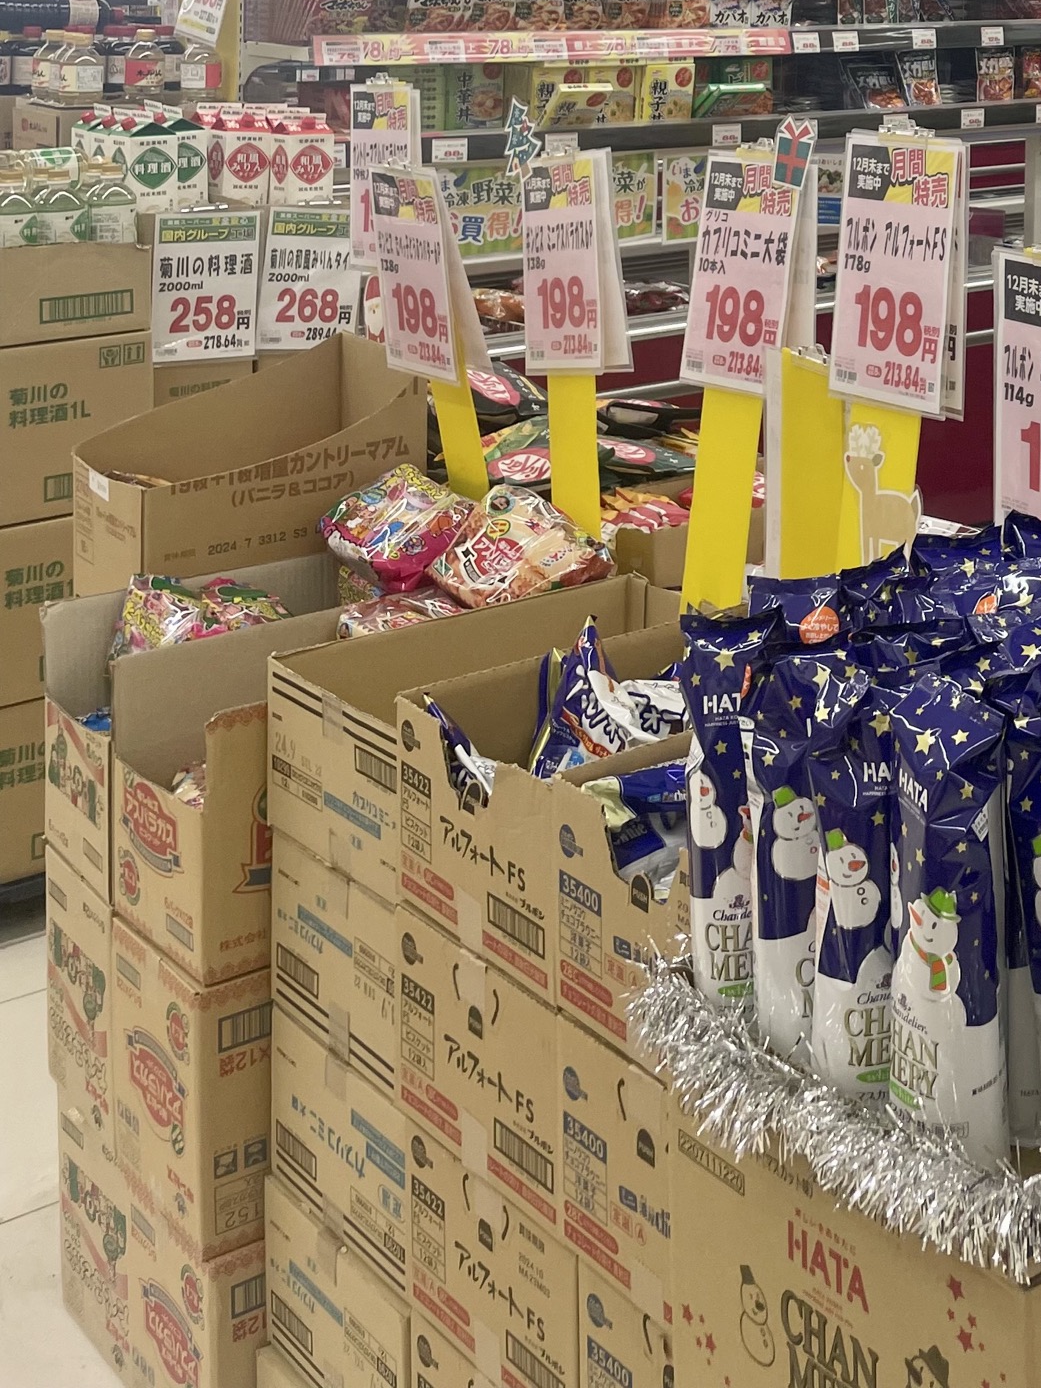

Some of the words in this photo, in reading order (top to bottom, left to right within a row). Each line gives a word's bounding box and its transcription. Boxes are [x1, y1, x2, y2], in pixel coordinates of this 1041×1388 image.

[457, 71, 475, 124] 中華丼
[134, 162, 171, 176] 料理酒
[743, 164, 773, 195] 月間
[853, 156, 891, 176] 12月末まで
[891, 148, 926, 183] 月間
[711, 171, 744, 190] 12月末まで
[713, 187, 736, 202] 実施中
[857, 174, 882, 191] 実施中
[913, 173, 949, 209] 特売
[706, 209, 729, 224] グリコ
[761, 189, 793, 217] 特売
[161, 227, 255, 242] 国内グループ工場
[702, 224, 789, 267] カプリコミニ大袋
[846, 216, 877, 254] ブルボン
[884, 220, 947, 262] アルフォートFS
[159, 253, 253, 279] 菊川の料理酒
[527, 255, 545, 271] 138g
[698, 257, 726, 275] 10本入
[844, 252, 871, 273] 178g
[159, 281, 204, 293] 2000ml
[268, 273, 310, 283] 2000ml
[1004, 344, 1034, 383] ブルボン
[9, 383, 68, 407] 菊川の
[1004, 382, 1035, 408] 114g
[9, 400, 91, 429] 料理酒1L
[207, 539, 237, 556] 2024
[244, 537, 251, 550] 7
[258, 531, 286, 546] 3312
[293, 527, 307, 540] S3
[4, 560, 65, 588] 菊川の
[402, 763, 431, 795] 35422
[899, 768, 928, 813] HATA
[440, 815, 505, 877] アルフォート
[507, 860, 526, 892] FS
[562, 873, 600, 913] 35400
[402, 975, 434, 1008] 35422
[444, 1034, 513, 1104] アルフォート
[514, 1089, 535, 1124] FS
[565, 1115, 607, 1161] 35400
[411, 1179, 445, 1217] 35422
[787, 1219, 870, 1314] HATA
[454, 1240, 525, 1318] アルフォート
[526, 1307, 546, 1342] FS
[590, 1340, 631, 1388] 35400
